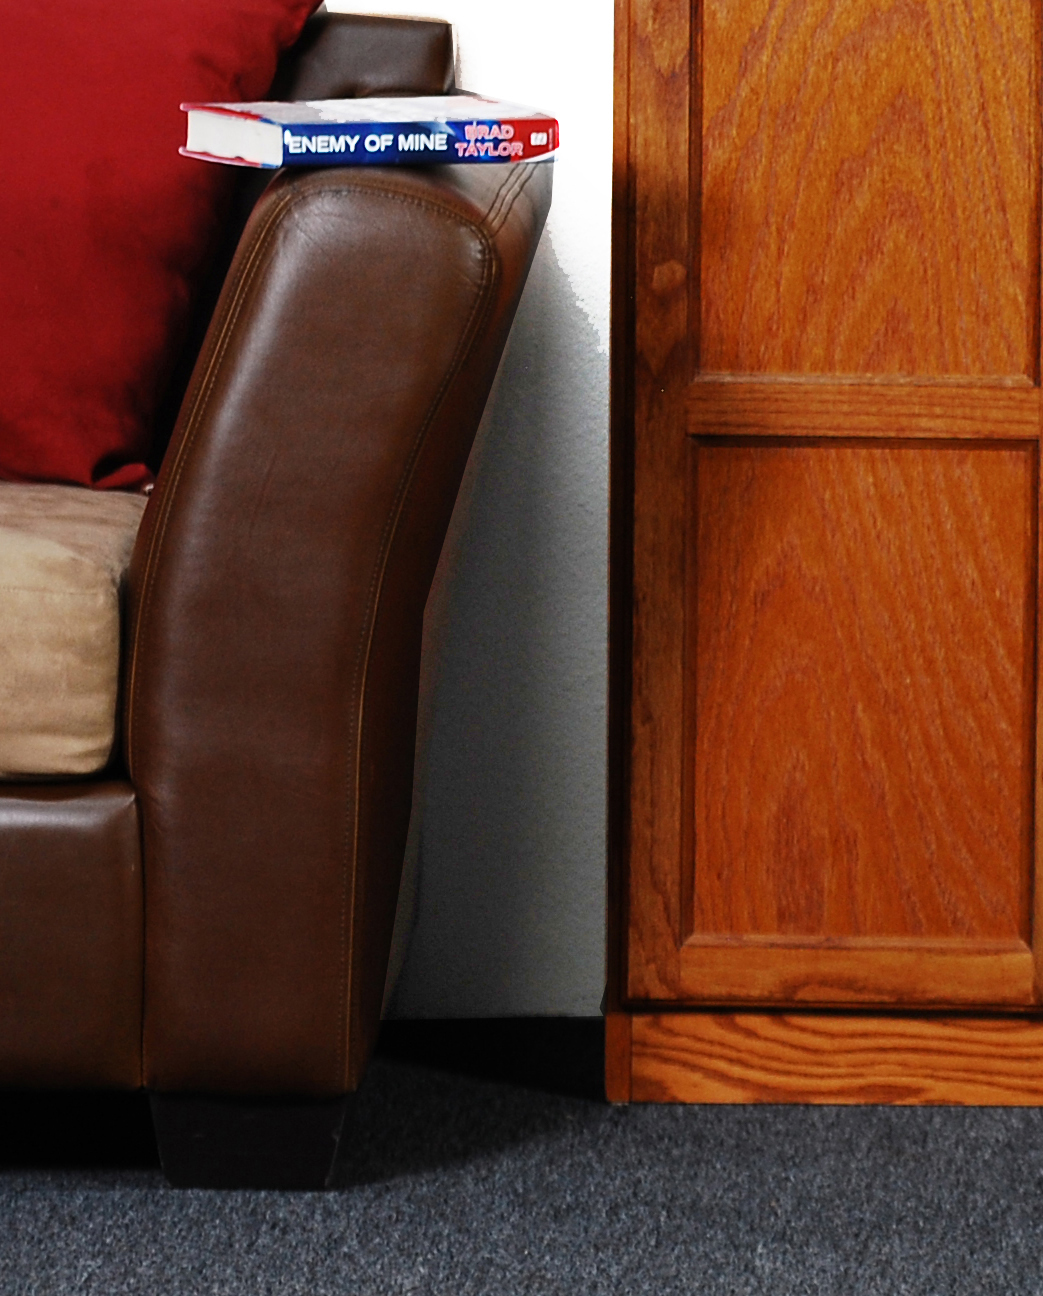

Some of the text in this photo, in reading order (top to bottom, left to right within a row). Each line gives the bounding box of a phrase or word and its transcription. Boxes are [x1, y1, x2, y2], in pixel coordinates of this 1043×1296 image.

[464, 124, 514, 140] BRAD
[289, 133, 448, 154] ENEMY OF MINE
[454, 142, 524, 157] TAYLOR
